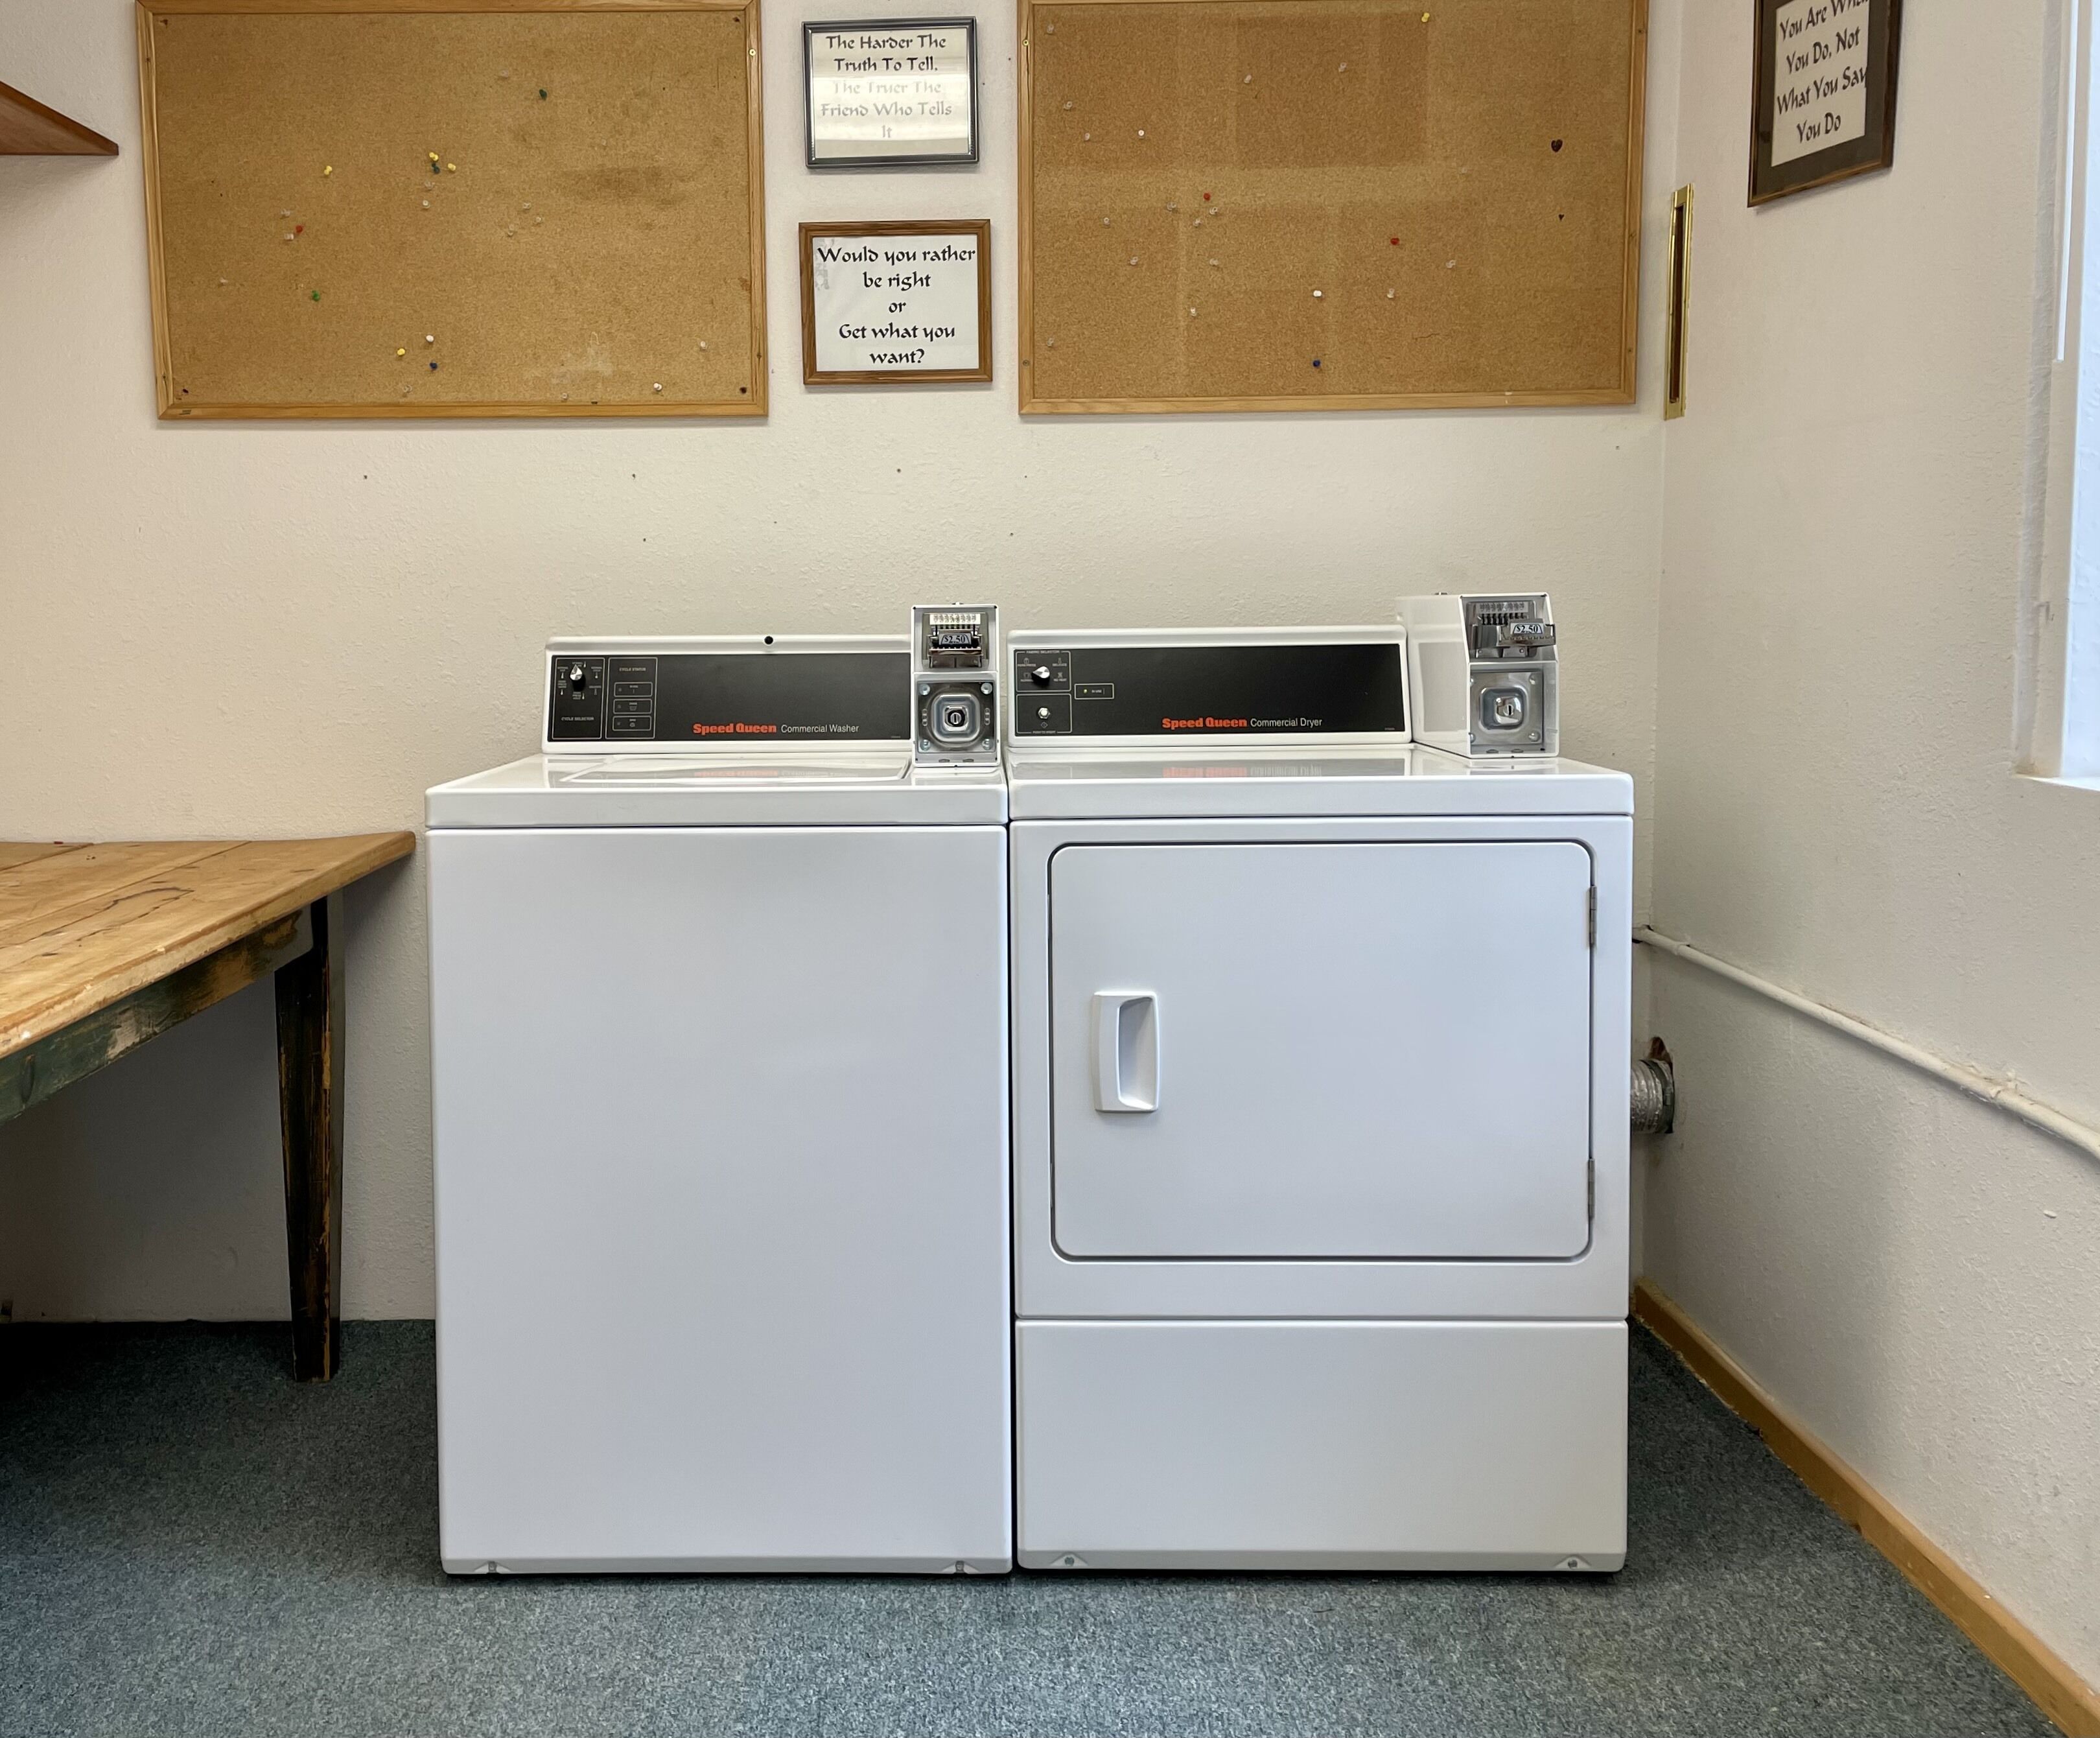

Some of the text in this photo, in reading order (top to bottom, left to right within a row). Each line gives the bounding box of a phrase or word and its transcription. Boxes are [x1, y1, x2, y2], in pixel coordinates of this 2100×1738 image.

[1780, 17, 1802, 41] You
[1805, 6, 1827, 30] Are
[826, 34, 946, 49] The Harder The
[1786, 26, 1861, 75] You Do, Not
[834, 56, 938, 71] Truth To Tell.
[834, 80, 941, 95] The Truer The
[1777, 86, 1811, 115] What
[1813, 75, 1839, 100] You
[821, 100, 952, 117] Friend Who Tells
[881, 125, 892, 138] It
[1797, 112, 1841, 143] You Do
[817, 244, 975, 266] Would you rather
[863, 271, 931, 291] be right
[889, 301, 906, 312] or
[839, 322, 955, 342] Get what you
[869, 348, 925, 363] want?
[1516, 624, 1538, 633] $2.50
[693, 723, 859, 735] Speed Queen Commercial Washer
[1162, 718, 1322, 729] Speed Queen Commercial Dryer
